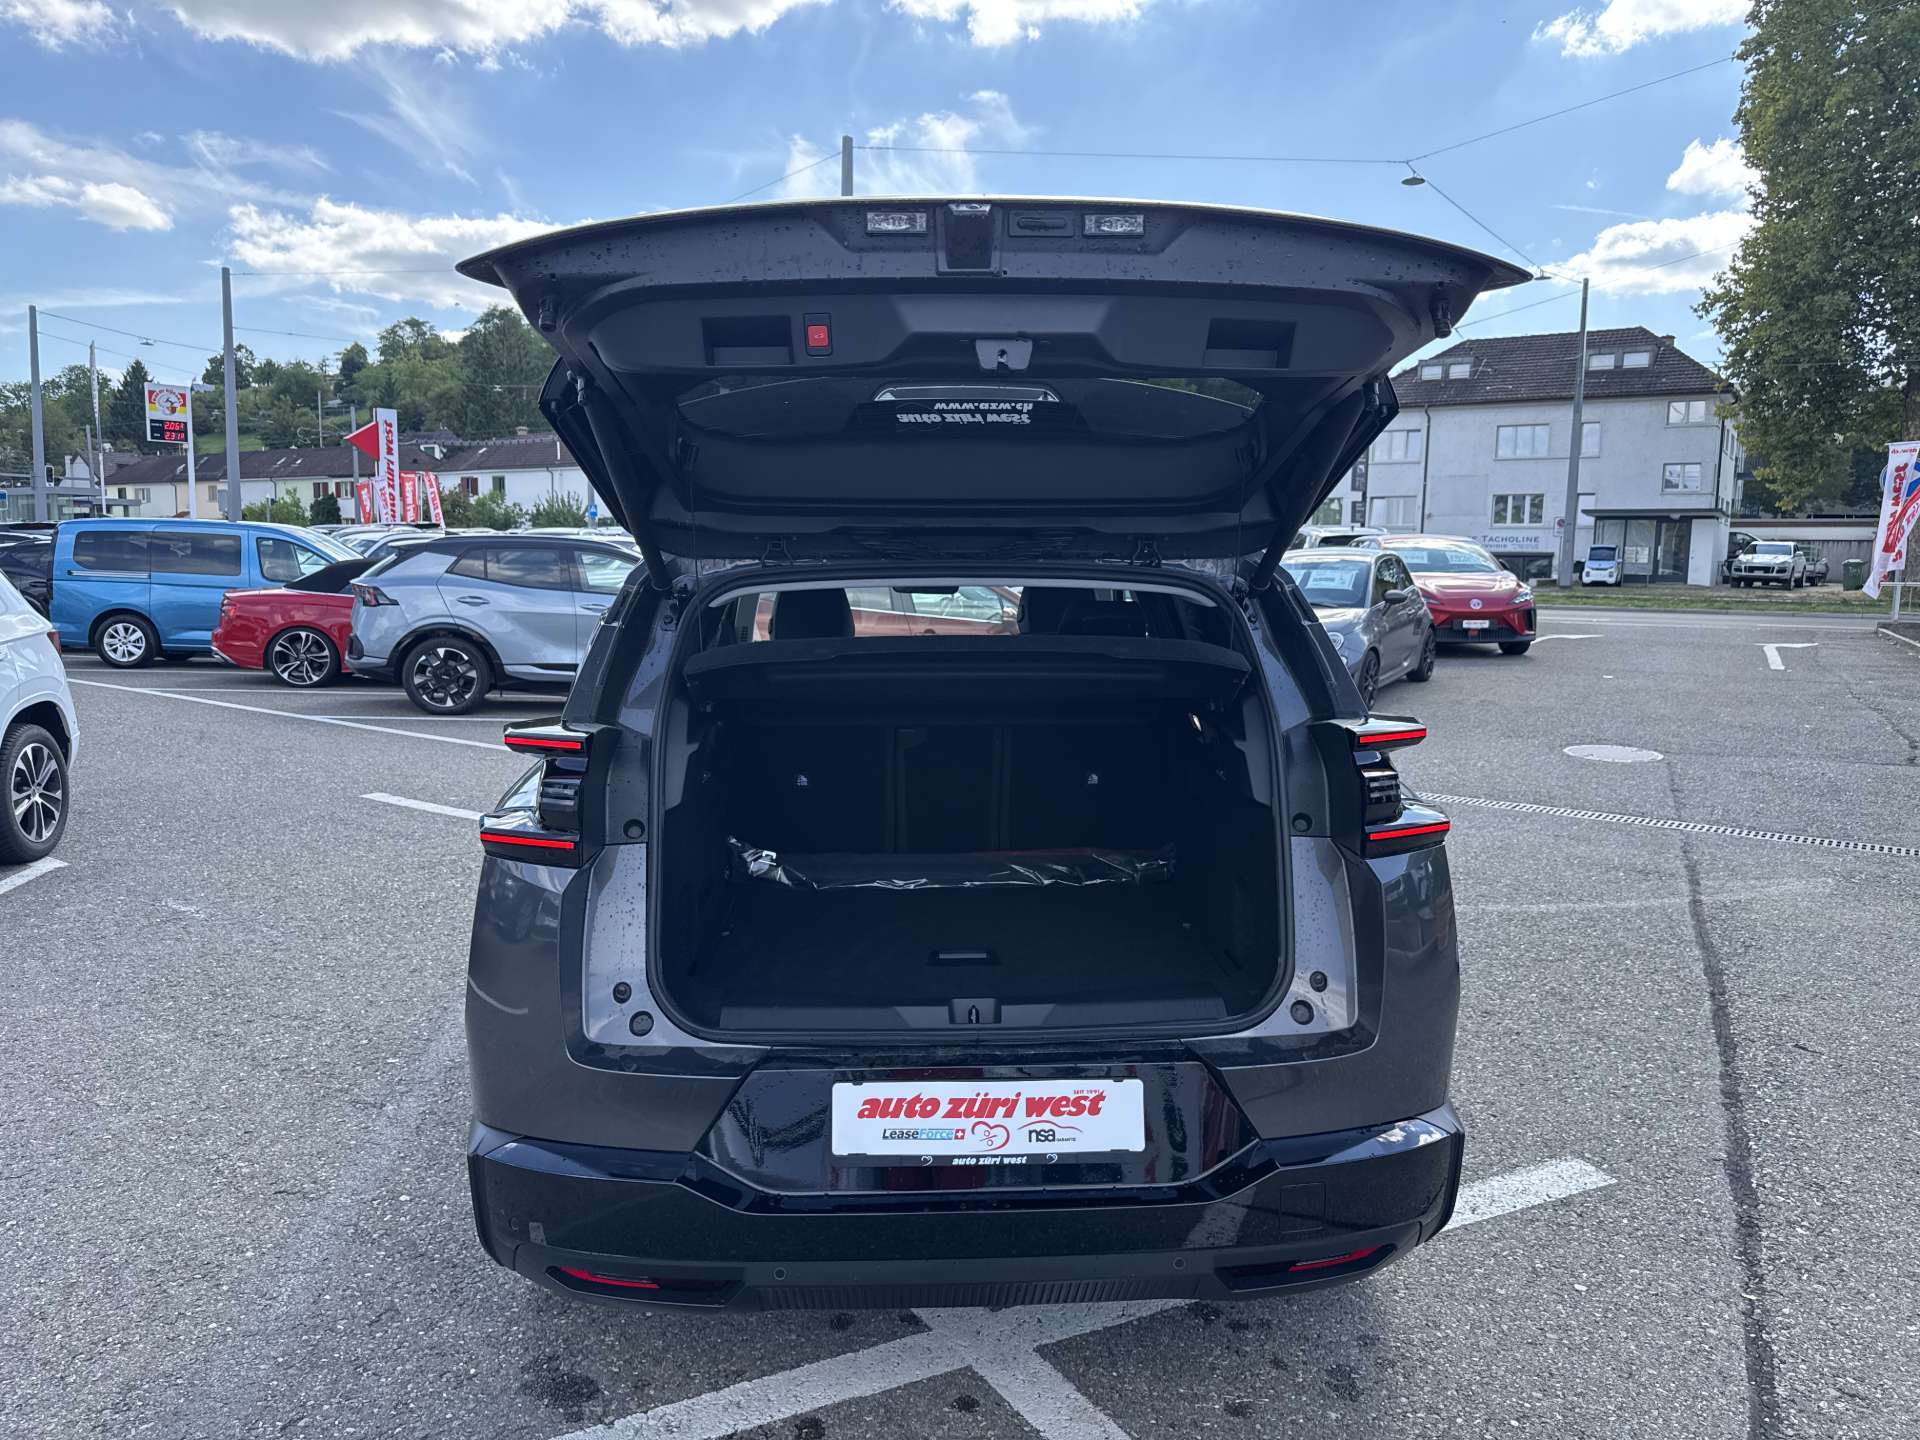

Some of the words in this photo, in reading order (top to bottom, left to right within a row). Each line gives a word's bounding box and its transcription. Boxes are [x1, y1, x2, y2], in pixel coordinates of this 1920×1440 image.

[383, 419, 395, 456] west
[857, 1093, 941, 1119] auto
[941, 1091, 1021, 1118] züri
[1025, 1090, 1107, 1118] west
[882, 1128, 954, 1141] LeaseForce
[1028, 1128, 1056, 1143] nsa
[952, 1156, 976, 1166] auto
[978, 1155, 1001, 1166] züri
[1003, 1155, 1027, 1165] west
